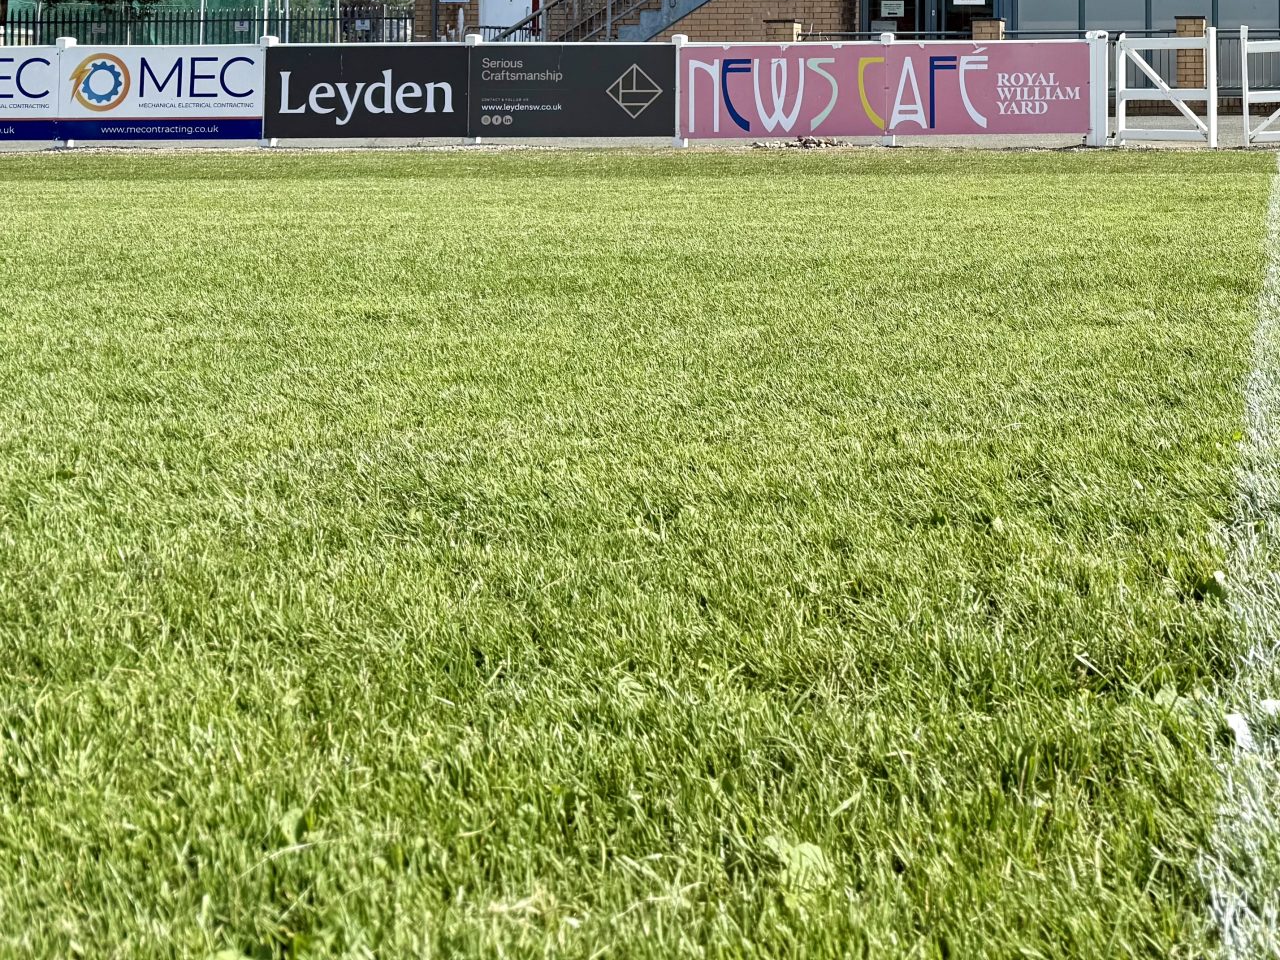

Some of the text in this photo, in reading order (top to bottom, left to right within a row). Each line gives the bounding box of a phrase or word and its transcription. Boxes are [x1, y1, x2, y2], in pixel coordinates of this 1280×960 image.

[481, 57, 524, 69] Serious
[139, 56, 255, 98] MEC
[481, 69, 563, 83] Craftsmanship
[997, 72, 1060, 86] ROYAL
[278, 68, 454, 126] Leyden
[688, 47, 989, 133] NEWS CAFÉ
[996, 86, 1081, 100] WILLIAM
[481, 103, 562, 112] www.leydensw.co.uk
[996, 101, 1048, 115] YARD
[101, 125, 219, 135] www.mecontracting.co.uk
